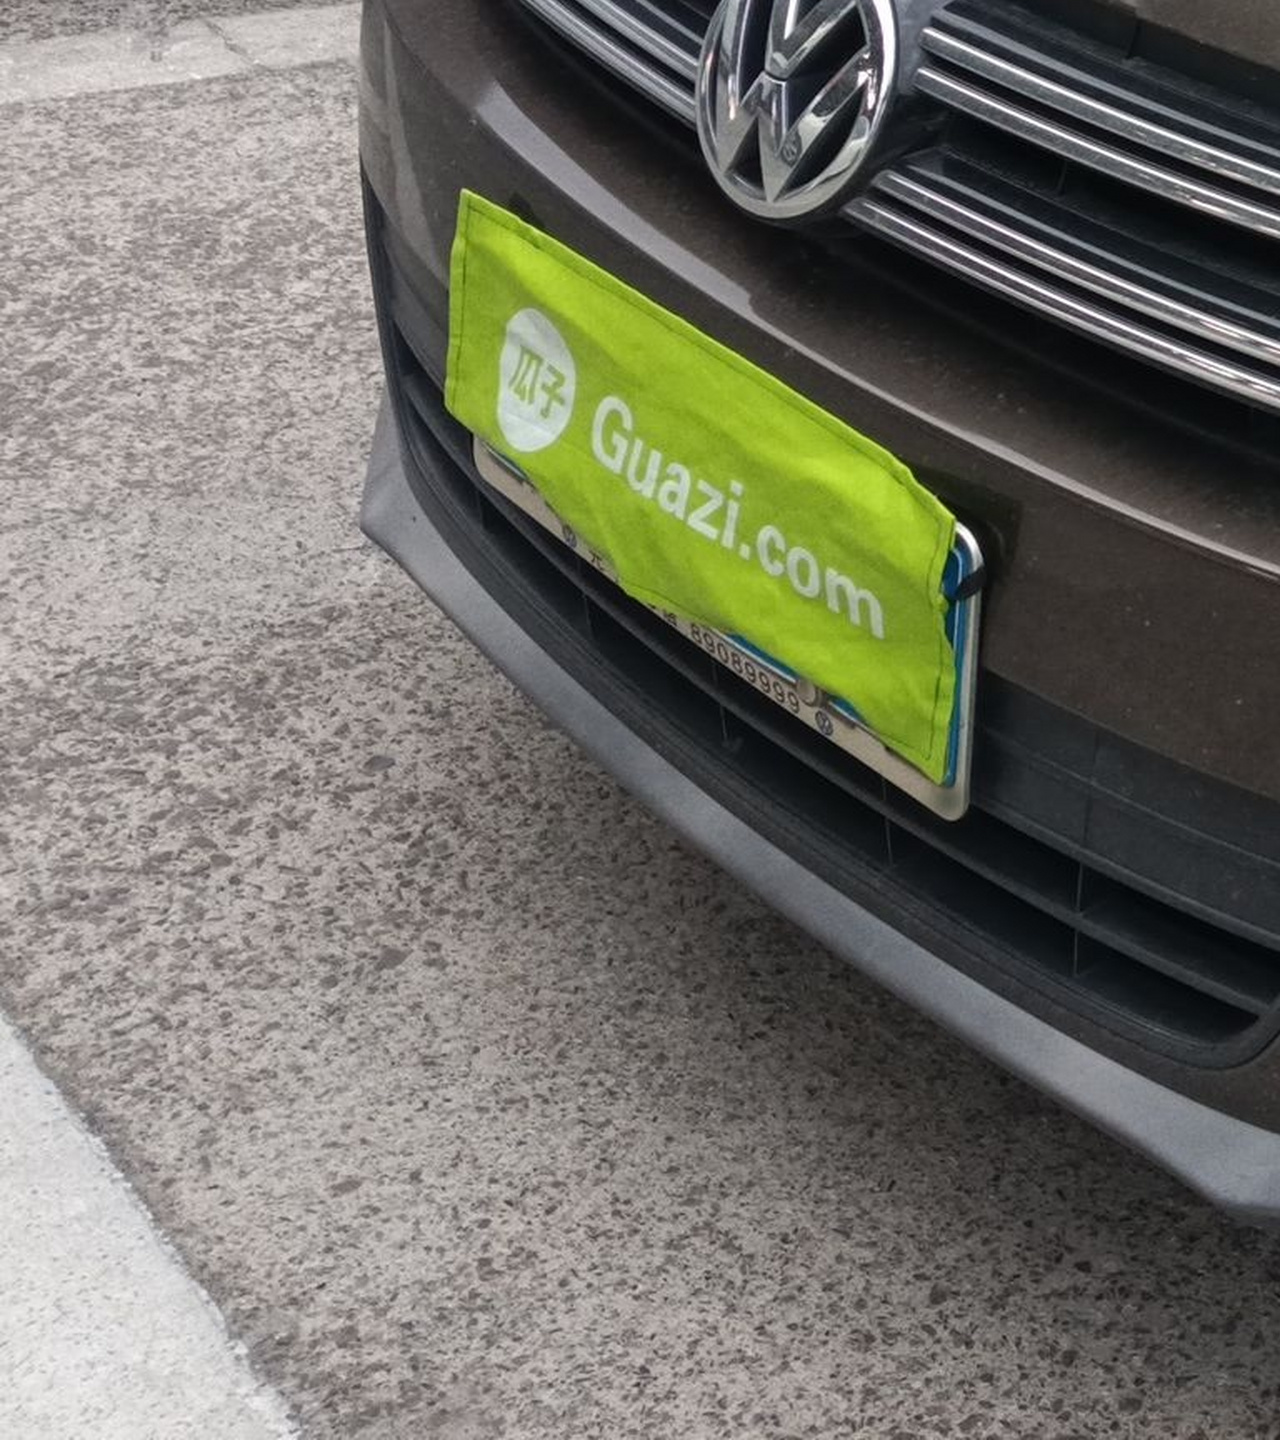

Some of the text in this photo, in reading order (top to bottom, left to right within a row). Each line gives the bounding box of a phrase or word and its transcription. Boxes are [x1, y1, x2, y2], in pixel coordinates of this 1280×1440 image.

[508, 344, 568, 420] 瓜子
[592, 396, 885, 639] Guazi.com
[690, 622, 800, 714] 89089999
